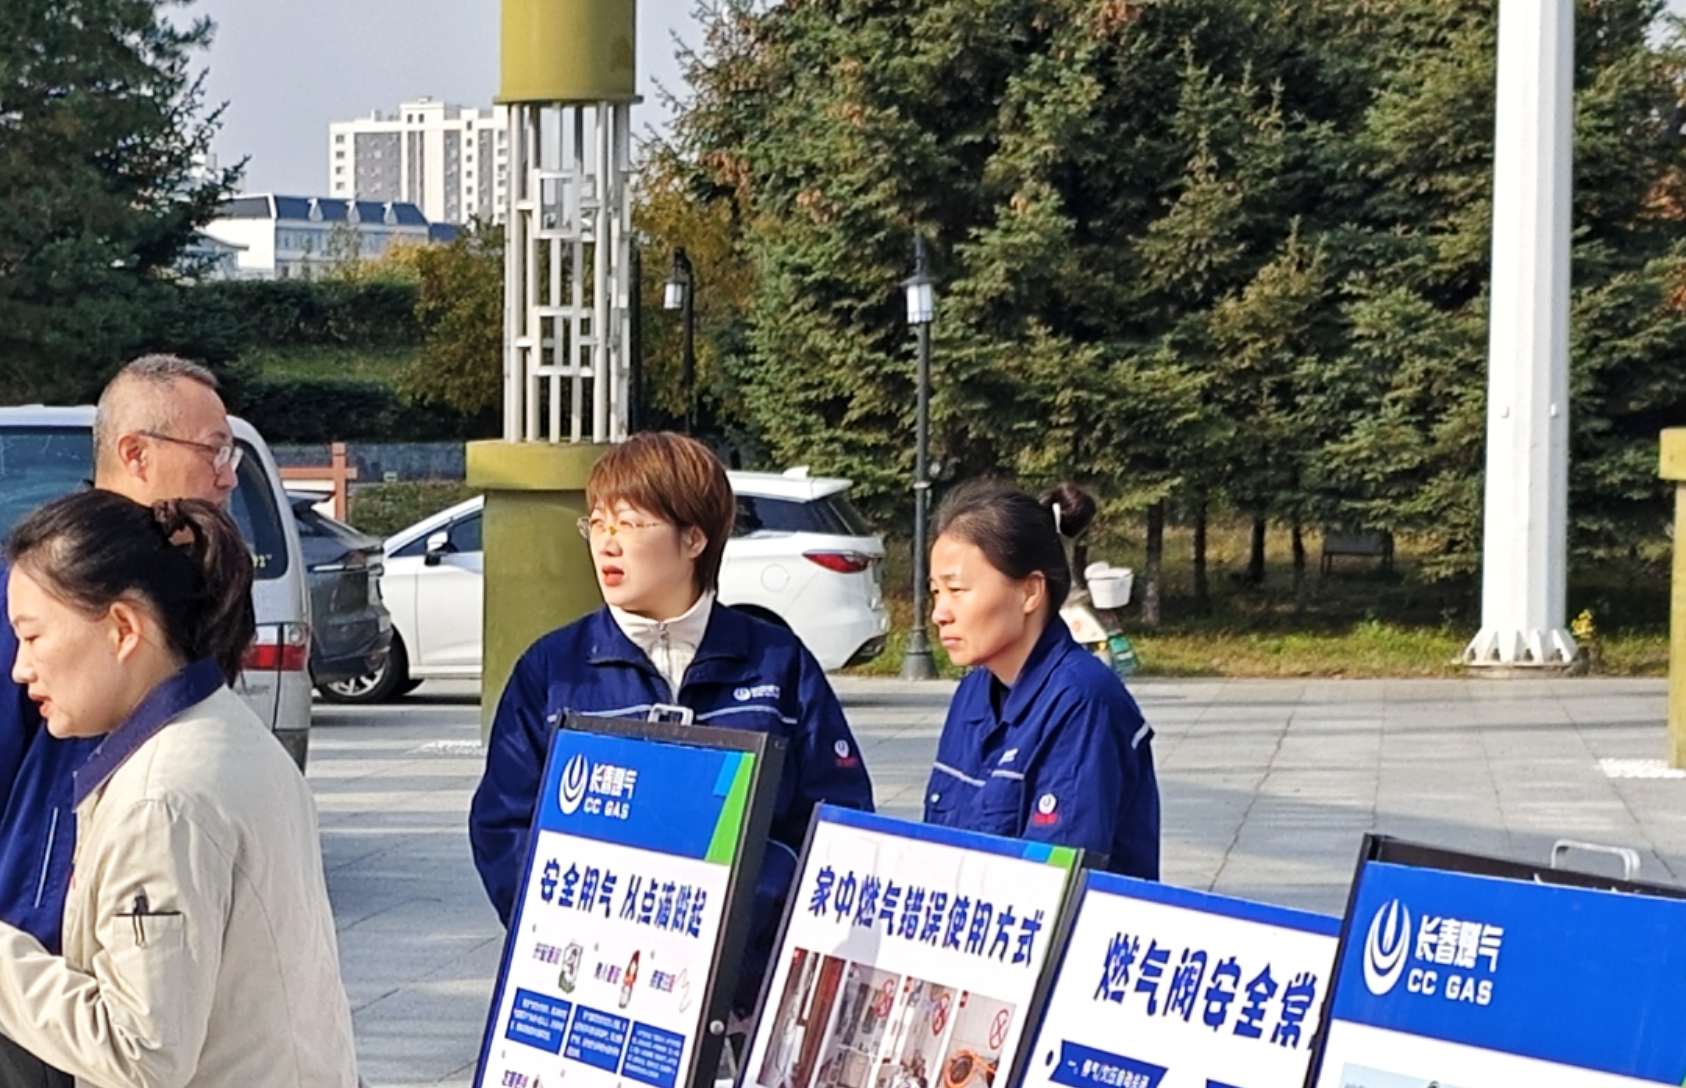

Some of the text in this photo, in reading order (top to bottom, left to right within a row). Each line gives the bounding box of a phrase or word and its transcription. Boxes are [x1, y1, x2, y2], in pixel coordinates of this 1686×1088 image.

[584, 796, 630, 820] CC GAS
[540, 857, 707, 938] 安全用气 从点滴做起
[806, 865, 1044, 969] 家中燃气错误使用方式
[1415, 914, 1504, 973] 长春燃气
[1093, 931, 1322, 1051] 燃气阀安全常
[1407, 968, 1493, 1006] CC GAS
